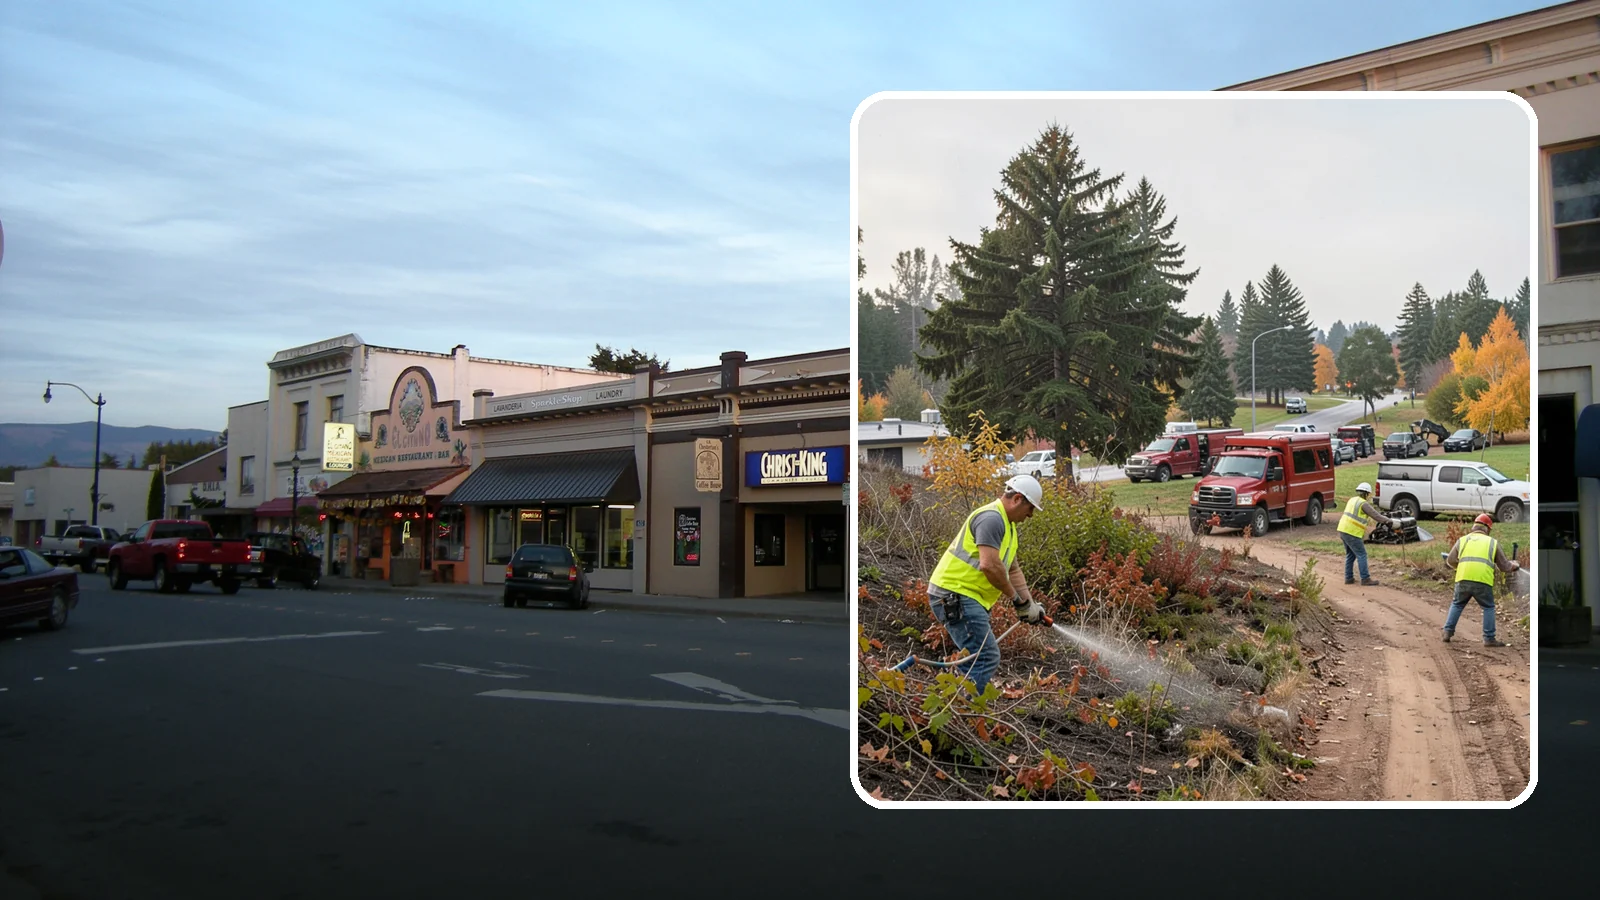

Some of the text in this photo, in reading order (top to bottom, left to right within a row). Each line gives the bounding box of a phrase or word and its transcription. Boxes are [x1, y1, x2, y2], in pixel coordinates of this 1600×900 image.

[561, 394, 583, 404] Shop
[596, 389, 623, 400] LAUNDRY
[493, 402, 522, 412] LAVANDERIA
[374, 454, 396, 464] MEXICAN
[397, 451, 433, 462] RESTAURANT
[438, 450, 450, 459] BAR
[761, 450, 827, 477] CHRIST KING
